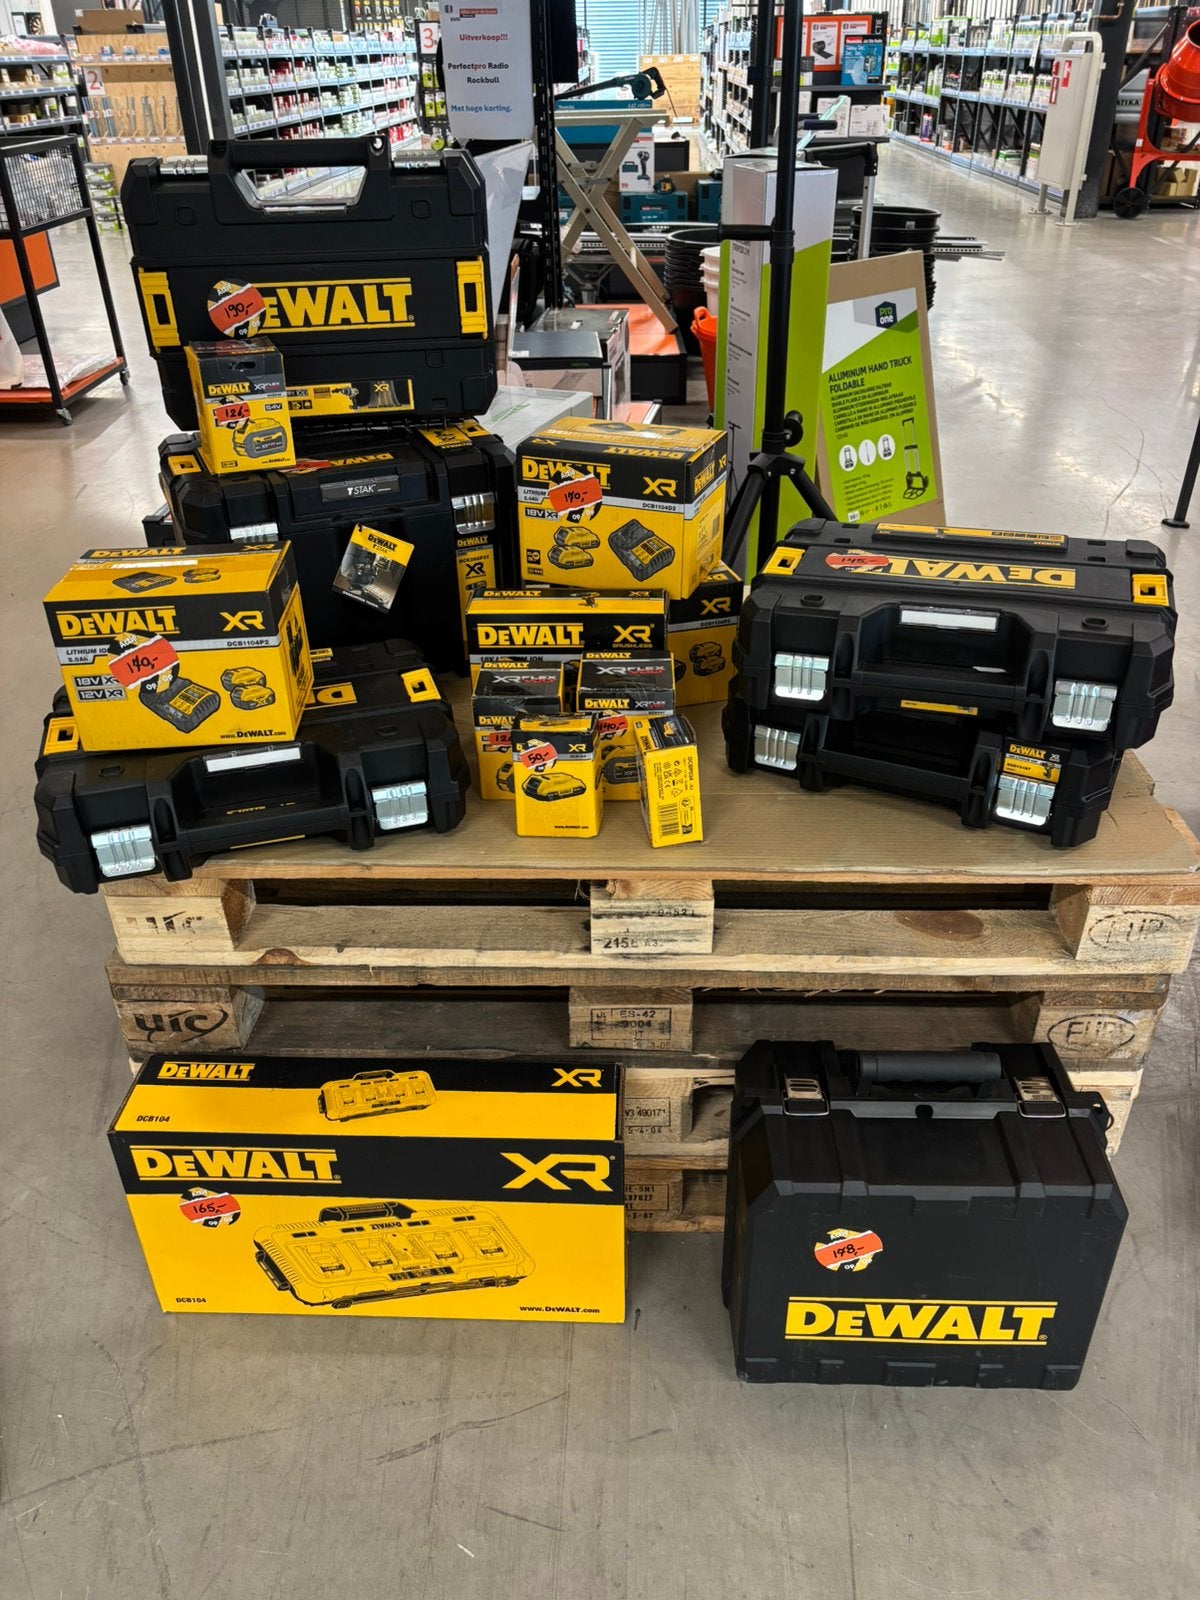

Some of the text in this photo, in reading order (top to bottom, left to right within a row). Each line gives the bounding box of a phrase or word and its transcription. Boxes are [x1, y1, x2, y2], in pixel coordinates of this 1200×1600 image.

[423, 28, 434, 48] 3
[460, 34, 508, 42] Uitverkoop!!!
[448, 62, 509, 70] Perfectpro Radio
[484, 105, 512, 113] korting.
[264, 284, 412, 327] EWALT
[880, 307, 892, 316] pro
[880, 314, 894, 324] one
[827, 355, 913, 383] ALUMINUM HAND TRUCK
[374, 384, 389, 392] XR
[829, 378, 865, 393] FOLDABLE
[522, 459, 676, 498] DEWT XR
[526, 508, 544, 517] 18V
[90, 548, 186, 558] DEWALT
[466, 562, 486, 576] XR
[889, 559, 1076, 588] DEWAL
[701, 598, 731, 615] XR
[56, 609, 266, 637] DEWALT XR
[478, 625, 652, 646] DEWALT XR
[66, 648, 96, 656] LITHIUM
[596, 667, 627, 675] XR
[76, 676, 100, 686] 18V
[492, 676, 521, 684] XR
[80, 688, 124, 698] 12V XR
[585, 700, 630, 708] DEWALT
[478, 716, 516, 726] DEWAL
[568, 744, 586, 752] XR
[1010, 744, 1046, 759] DEWALT
[158, 1063, 602, 1088] DEWALT XR
[130, 1150, 610, 1192] DEWALT XR
[193, 1202, 226, 1214] 165,-
[176, 1296, 206, 1304] DCB104
[520, 1304, 600, 1314] www.DEWALT.com
[785, 1302, 1056, 1341] DEWALT
